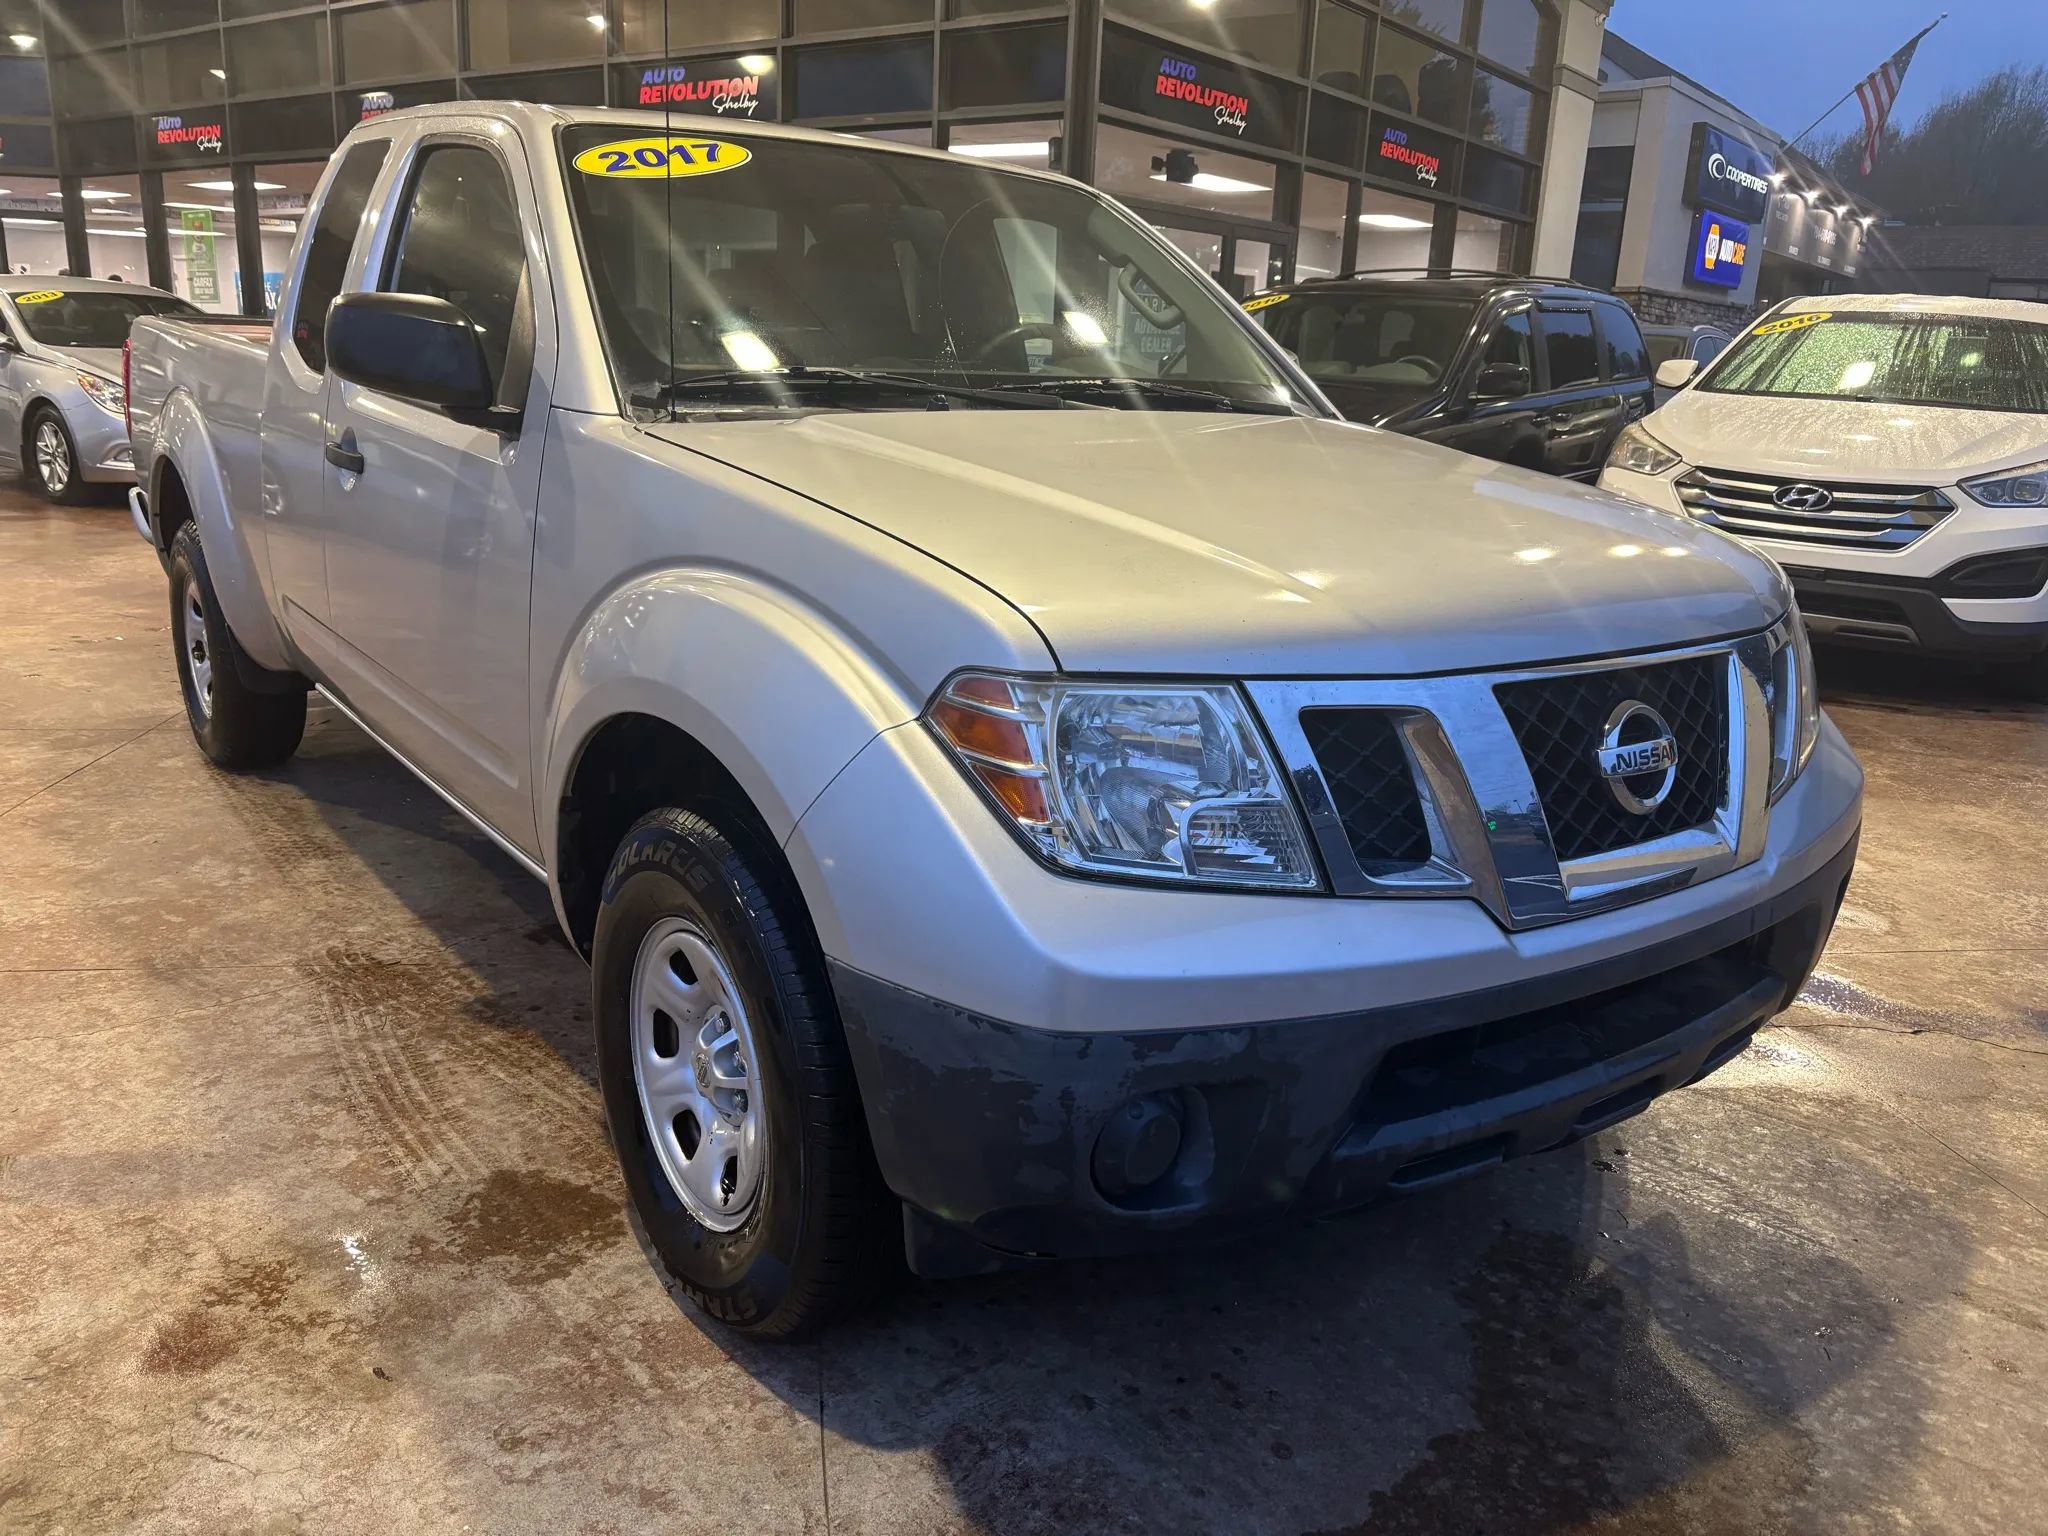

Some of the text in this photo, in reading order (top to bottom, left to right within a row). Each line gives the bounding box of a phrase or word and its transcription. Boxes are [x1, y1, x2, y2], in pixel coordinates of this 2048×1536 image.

[641, 66, 686, 84] AUTO
[1160, 57, 1197, 81] AUTO
[639, 75, 759, 104] REVOLUTION
[1155, 74, 1248, 115] REVOLUTION
[362, 94, 394, 111] AUTO
[712, 92, 759, 116] Shelby
[158, 116, 182, 130] AUTO
[1214, 105, 1247, 135] Shelby
[157, 124, 222, 144] REVOLUTION
[1383, 127, 1408, 145] AUTO
[598, 143, 721, 173] 2017
[1380, 141, 1440, 173] REVOLUTION
[1615, 742, 1677, 771] NISSAN
